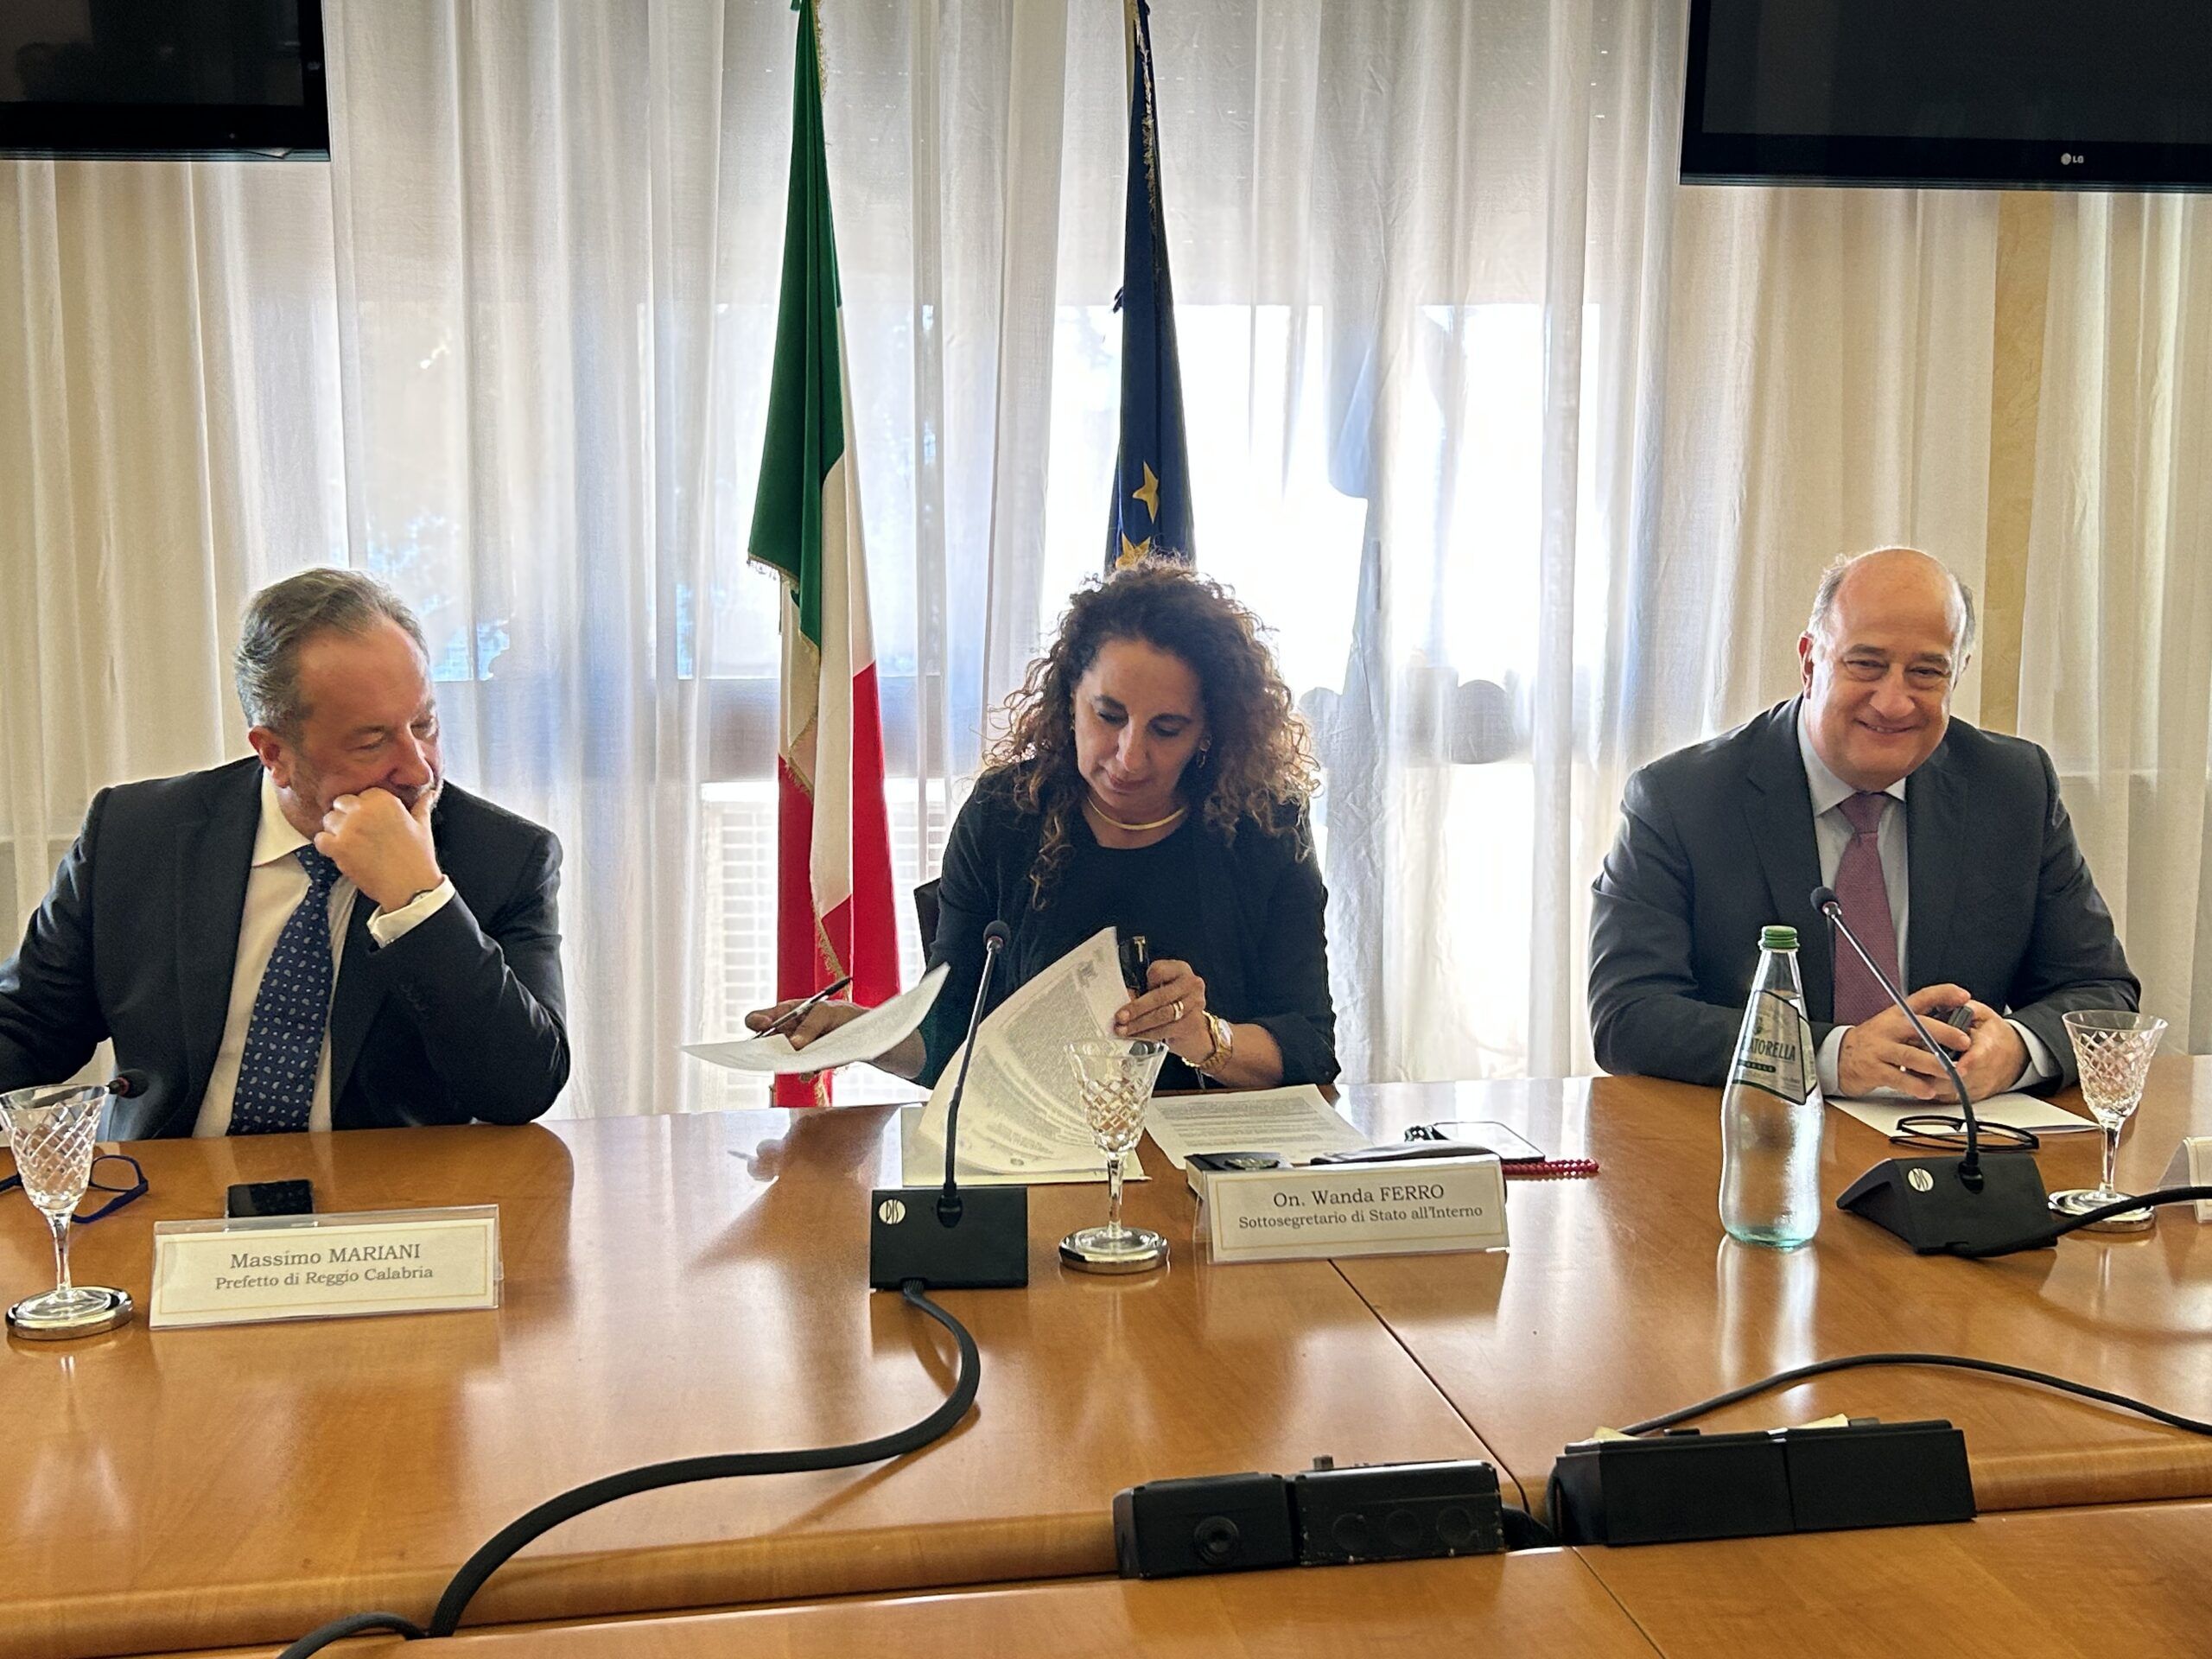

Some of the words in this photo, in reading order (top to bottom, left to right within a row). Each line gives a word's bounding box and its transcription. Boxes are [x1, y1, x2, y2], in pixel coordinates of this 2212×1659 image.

[2072, 155, 2084, 163] LG
[1747, 1039, 1796, 1062] ATORELLA
[1273, 1192, 1306, 1208] On.
[1311, 1187, 1375, 1205] Wanda
[1380, 1184, 1445, 1202] FERRO
[1238, 1211, 1347, 1230] Sottosegretario
[1351, 1209, 1365, 1223] di
[1369, 1209, 1407, 1222] Stato
[1411, 1205, 1484, 1219] all'Interno
[230, 1249, 321, 1268] Massimo
[328, 1243, 421, 1263] MARIANI
[215, 1274, 279, 1290] Prefetto
[283, 1272, 300, 1286] di
[306, 1269, 359, 1287] Reggio
[364, 1266, 434, 1281] Calabria
